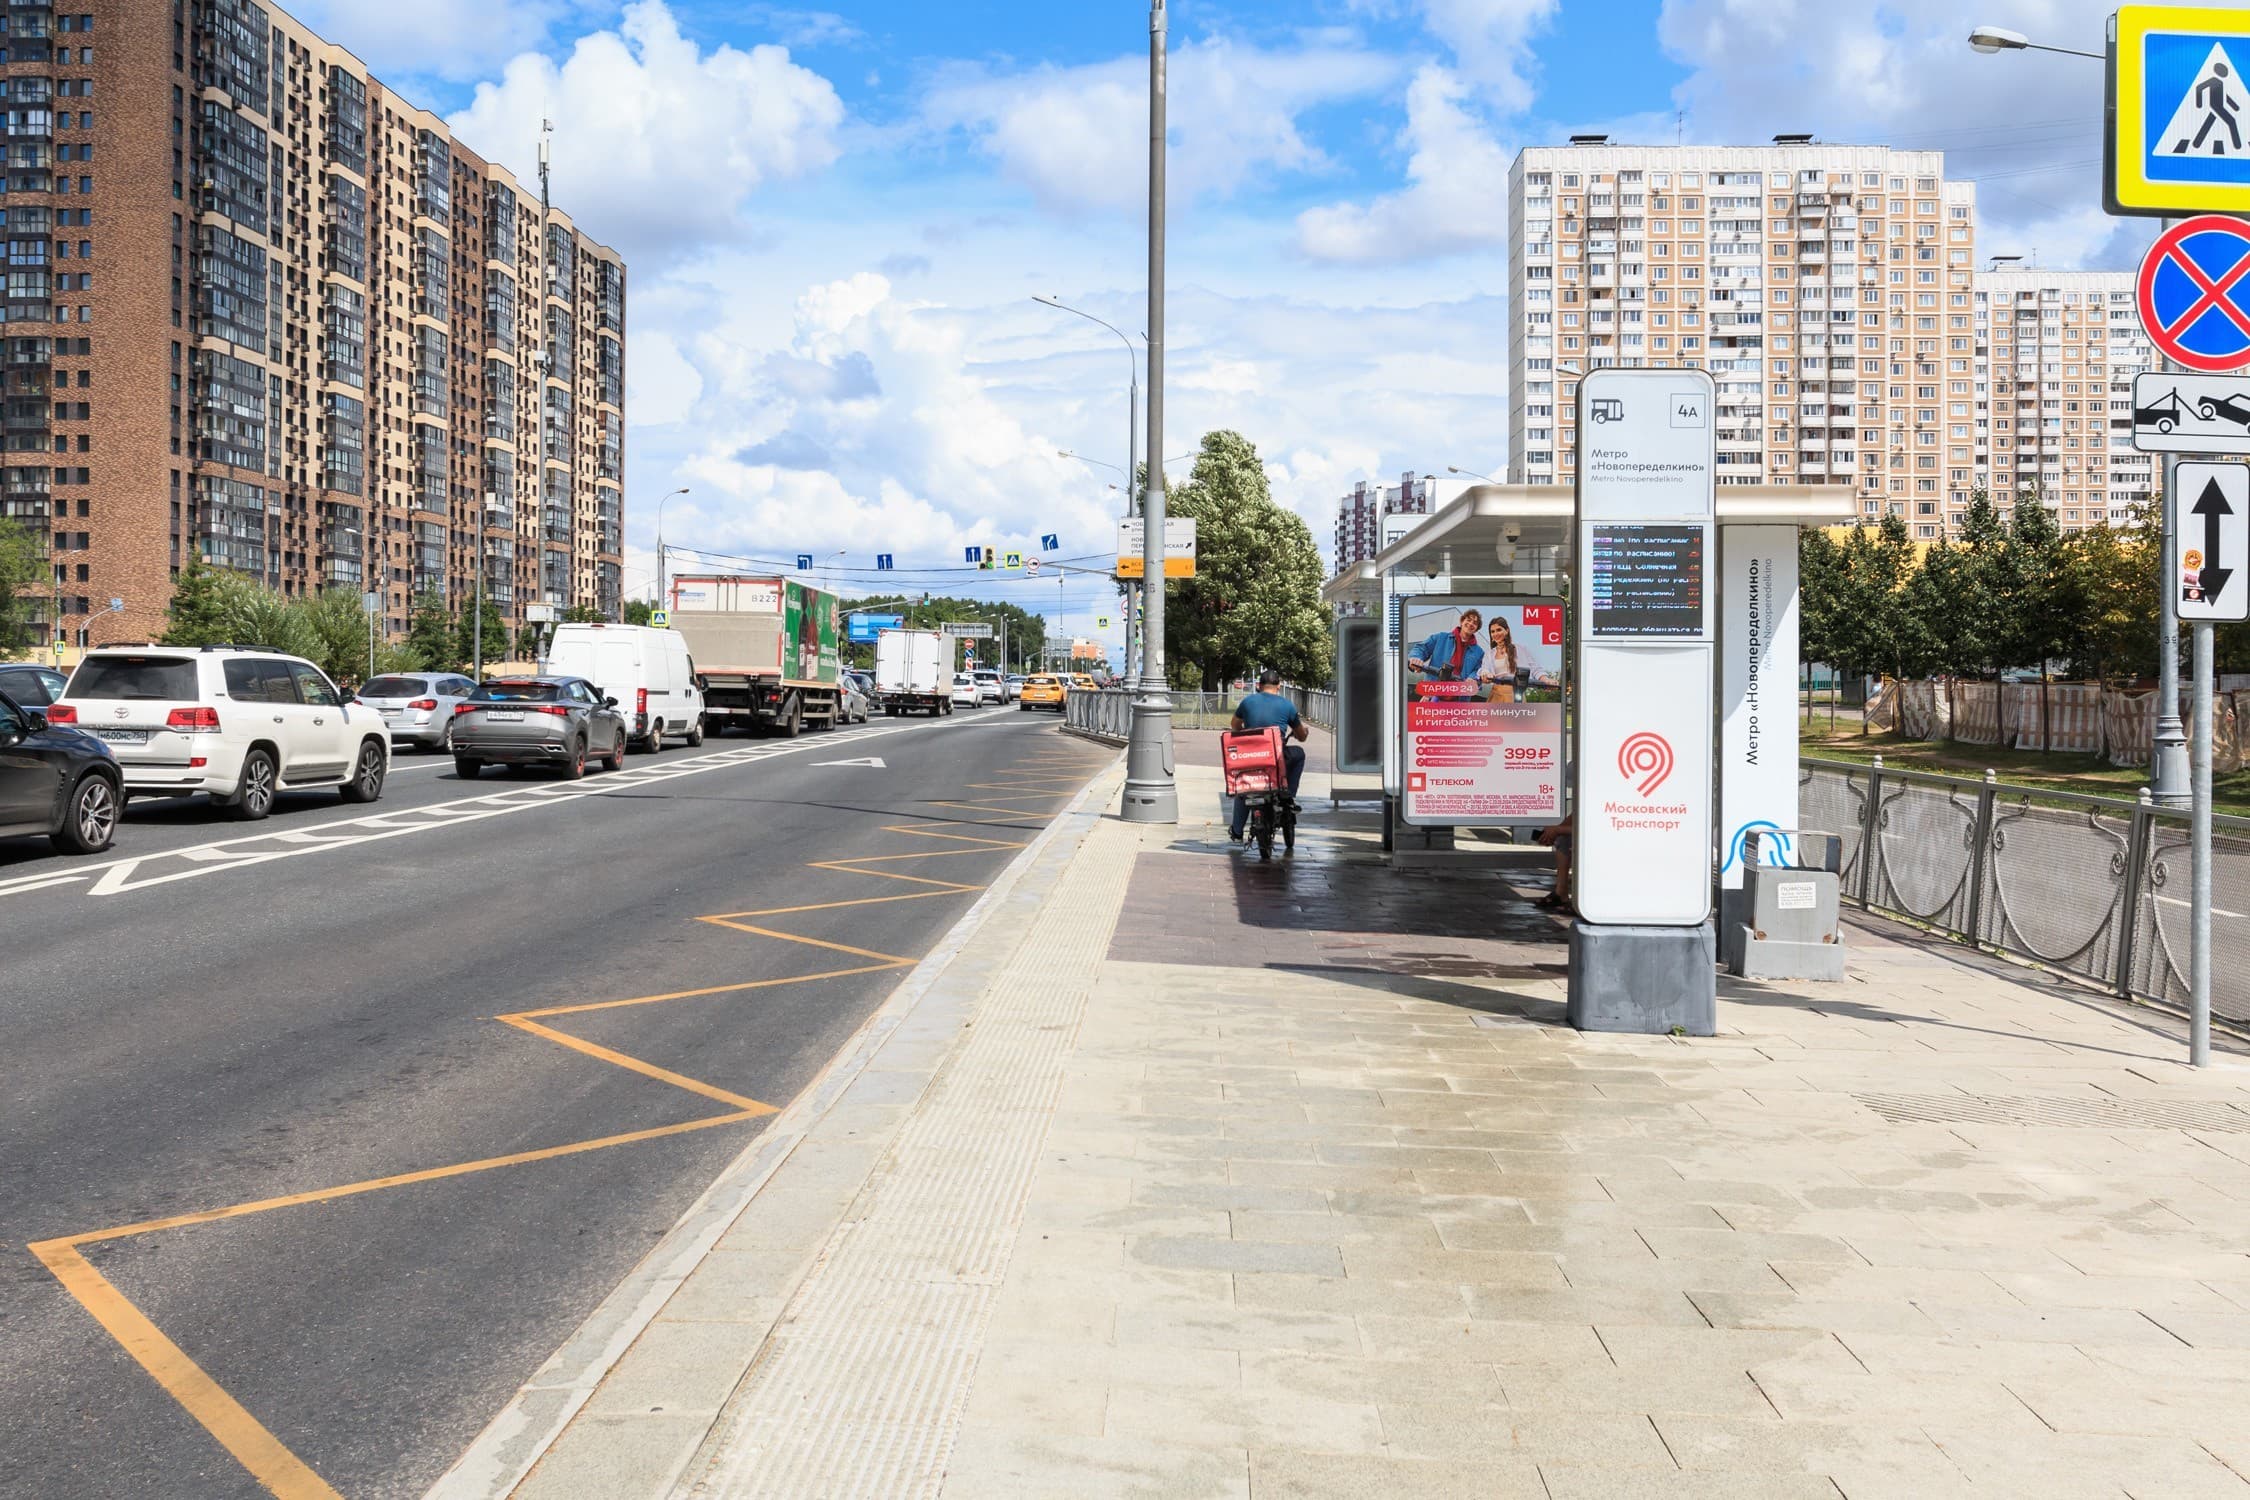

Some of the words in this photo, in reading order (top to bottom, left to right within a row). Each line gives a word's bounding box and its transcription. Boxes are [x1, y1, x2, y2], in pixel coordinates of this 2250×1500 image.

[1678, 404, 1698, 418] 4А
[1591, 449, 1628, 459] Метро
[1592, 461, 1704, 472] «Новопеределкино»
[1616, 474, 1683, 484] Novoperedelkino
[1763, 558, 1773, 639] Novoperedelkino
[1746, 558, 1760, 711] «Новопеределкино»
[1416, 707, 1487, 718] Переносите
[1491, 708, 1536, 718] минуты
[1426, 716, 1488, 726] гигабайты
[1746, 716, 1760, 765] Метро
[1505, 748, 1536, 759] 399
[1538, 748, 1550, 759] ₽
[1538, 785, 1555, 794] 18+
[1604, 802, 1687, 814] Московский
[1610, 817, 1680, 832] Транспорт
